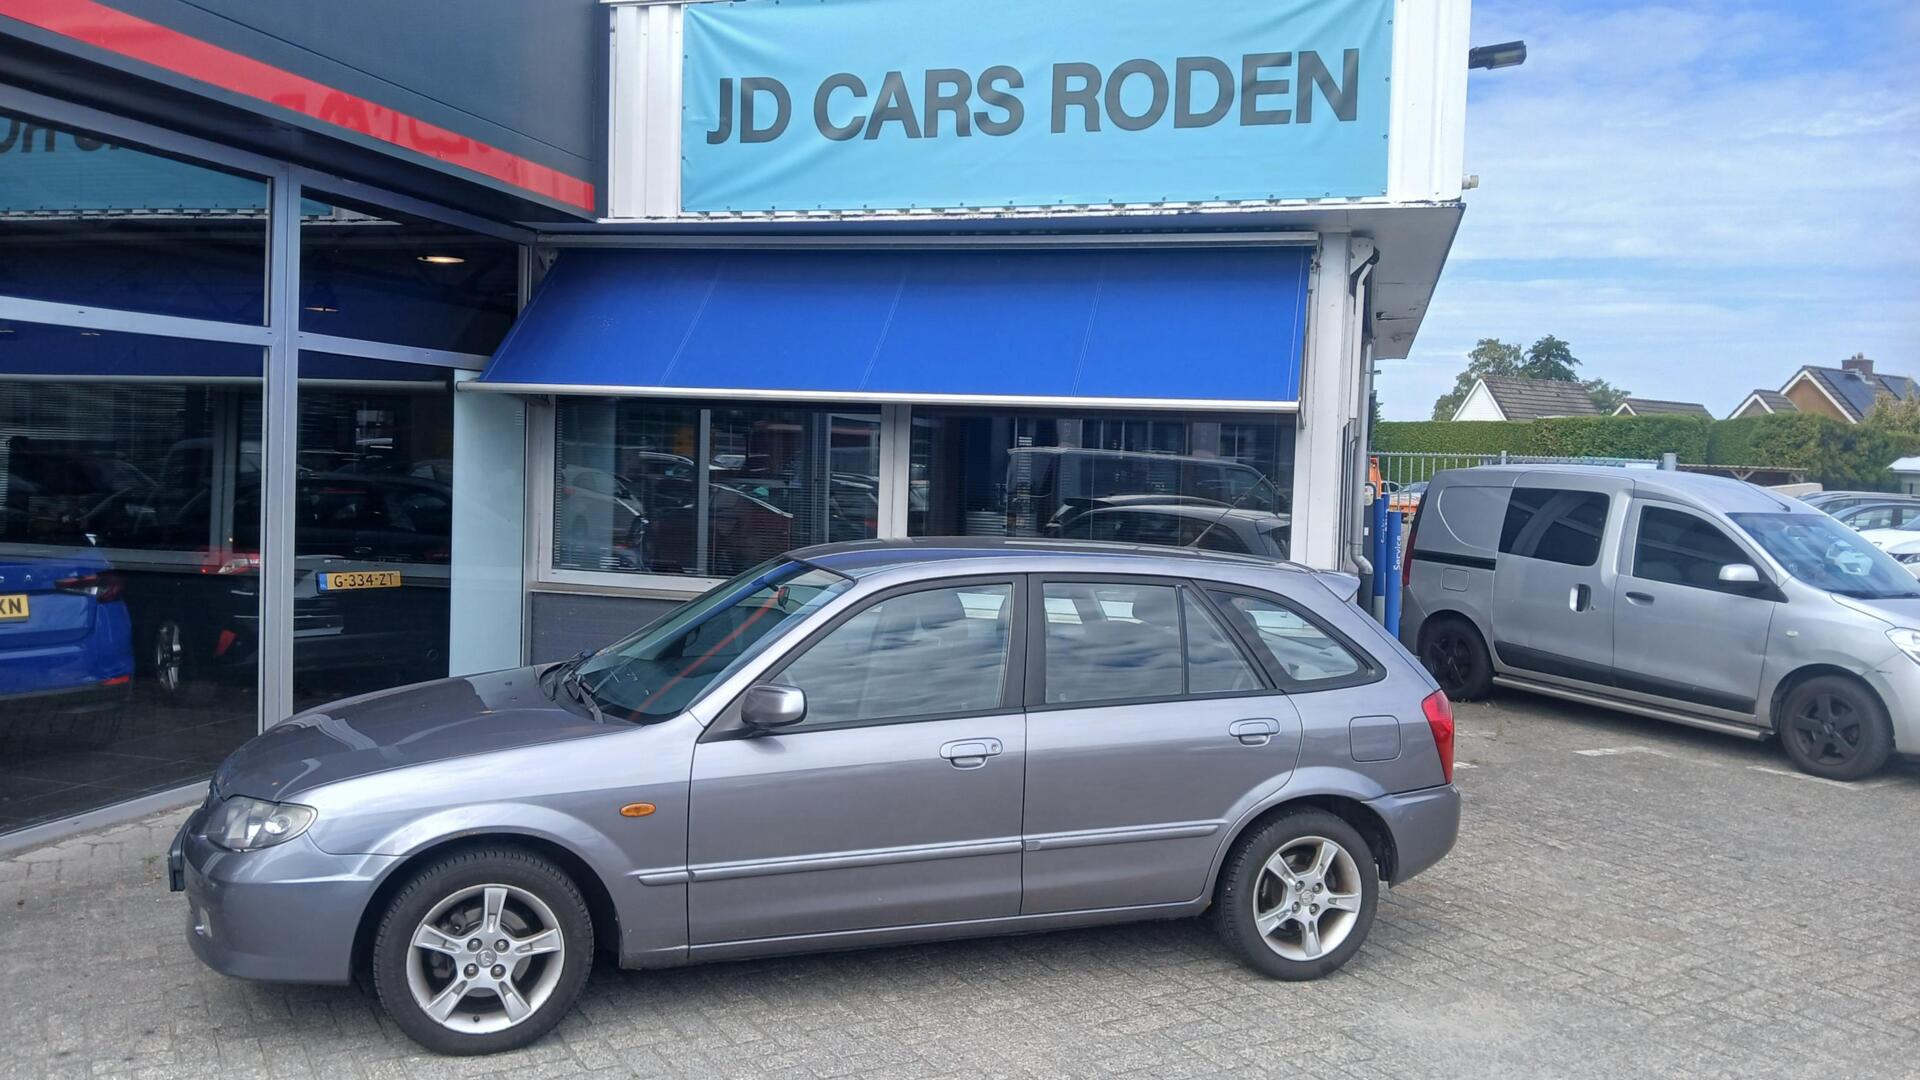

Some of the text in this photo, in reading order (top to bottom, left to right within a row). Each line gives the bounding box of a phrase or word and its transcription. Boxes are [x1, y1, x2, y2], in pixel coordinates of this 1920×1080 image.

[707, 48, 1359, 144] JD CARS RODEN
[334, 573, 394, 588] G-334-ZT
